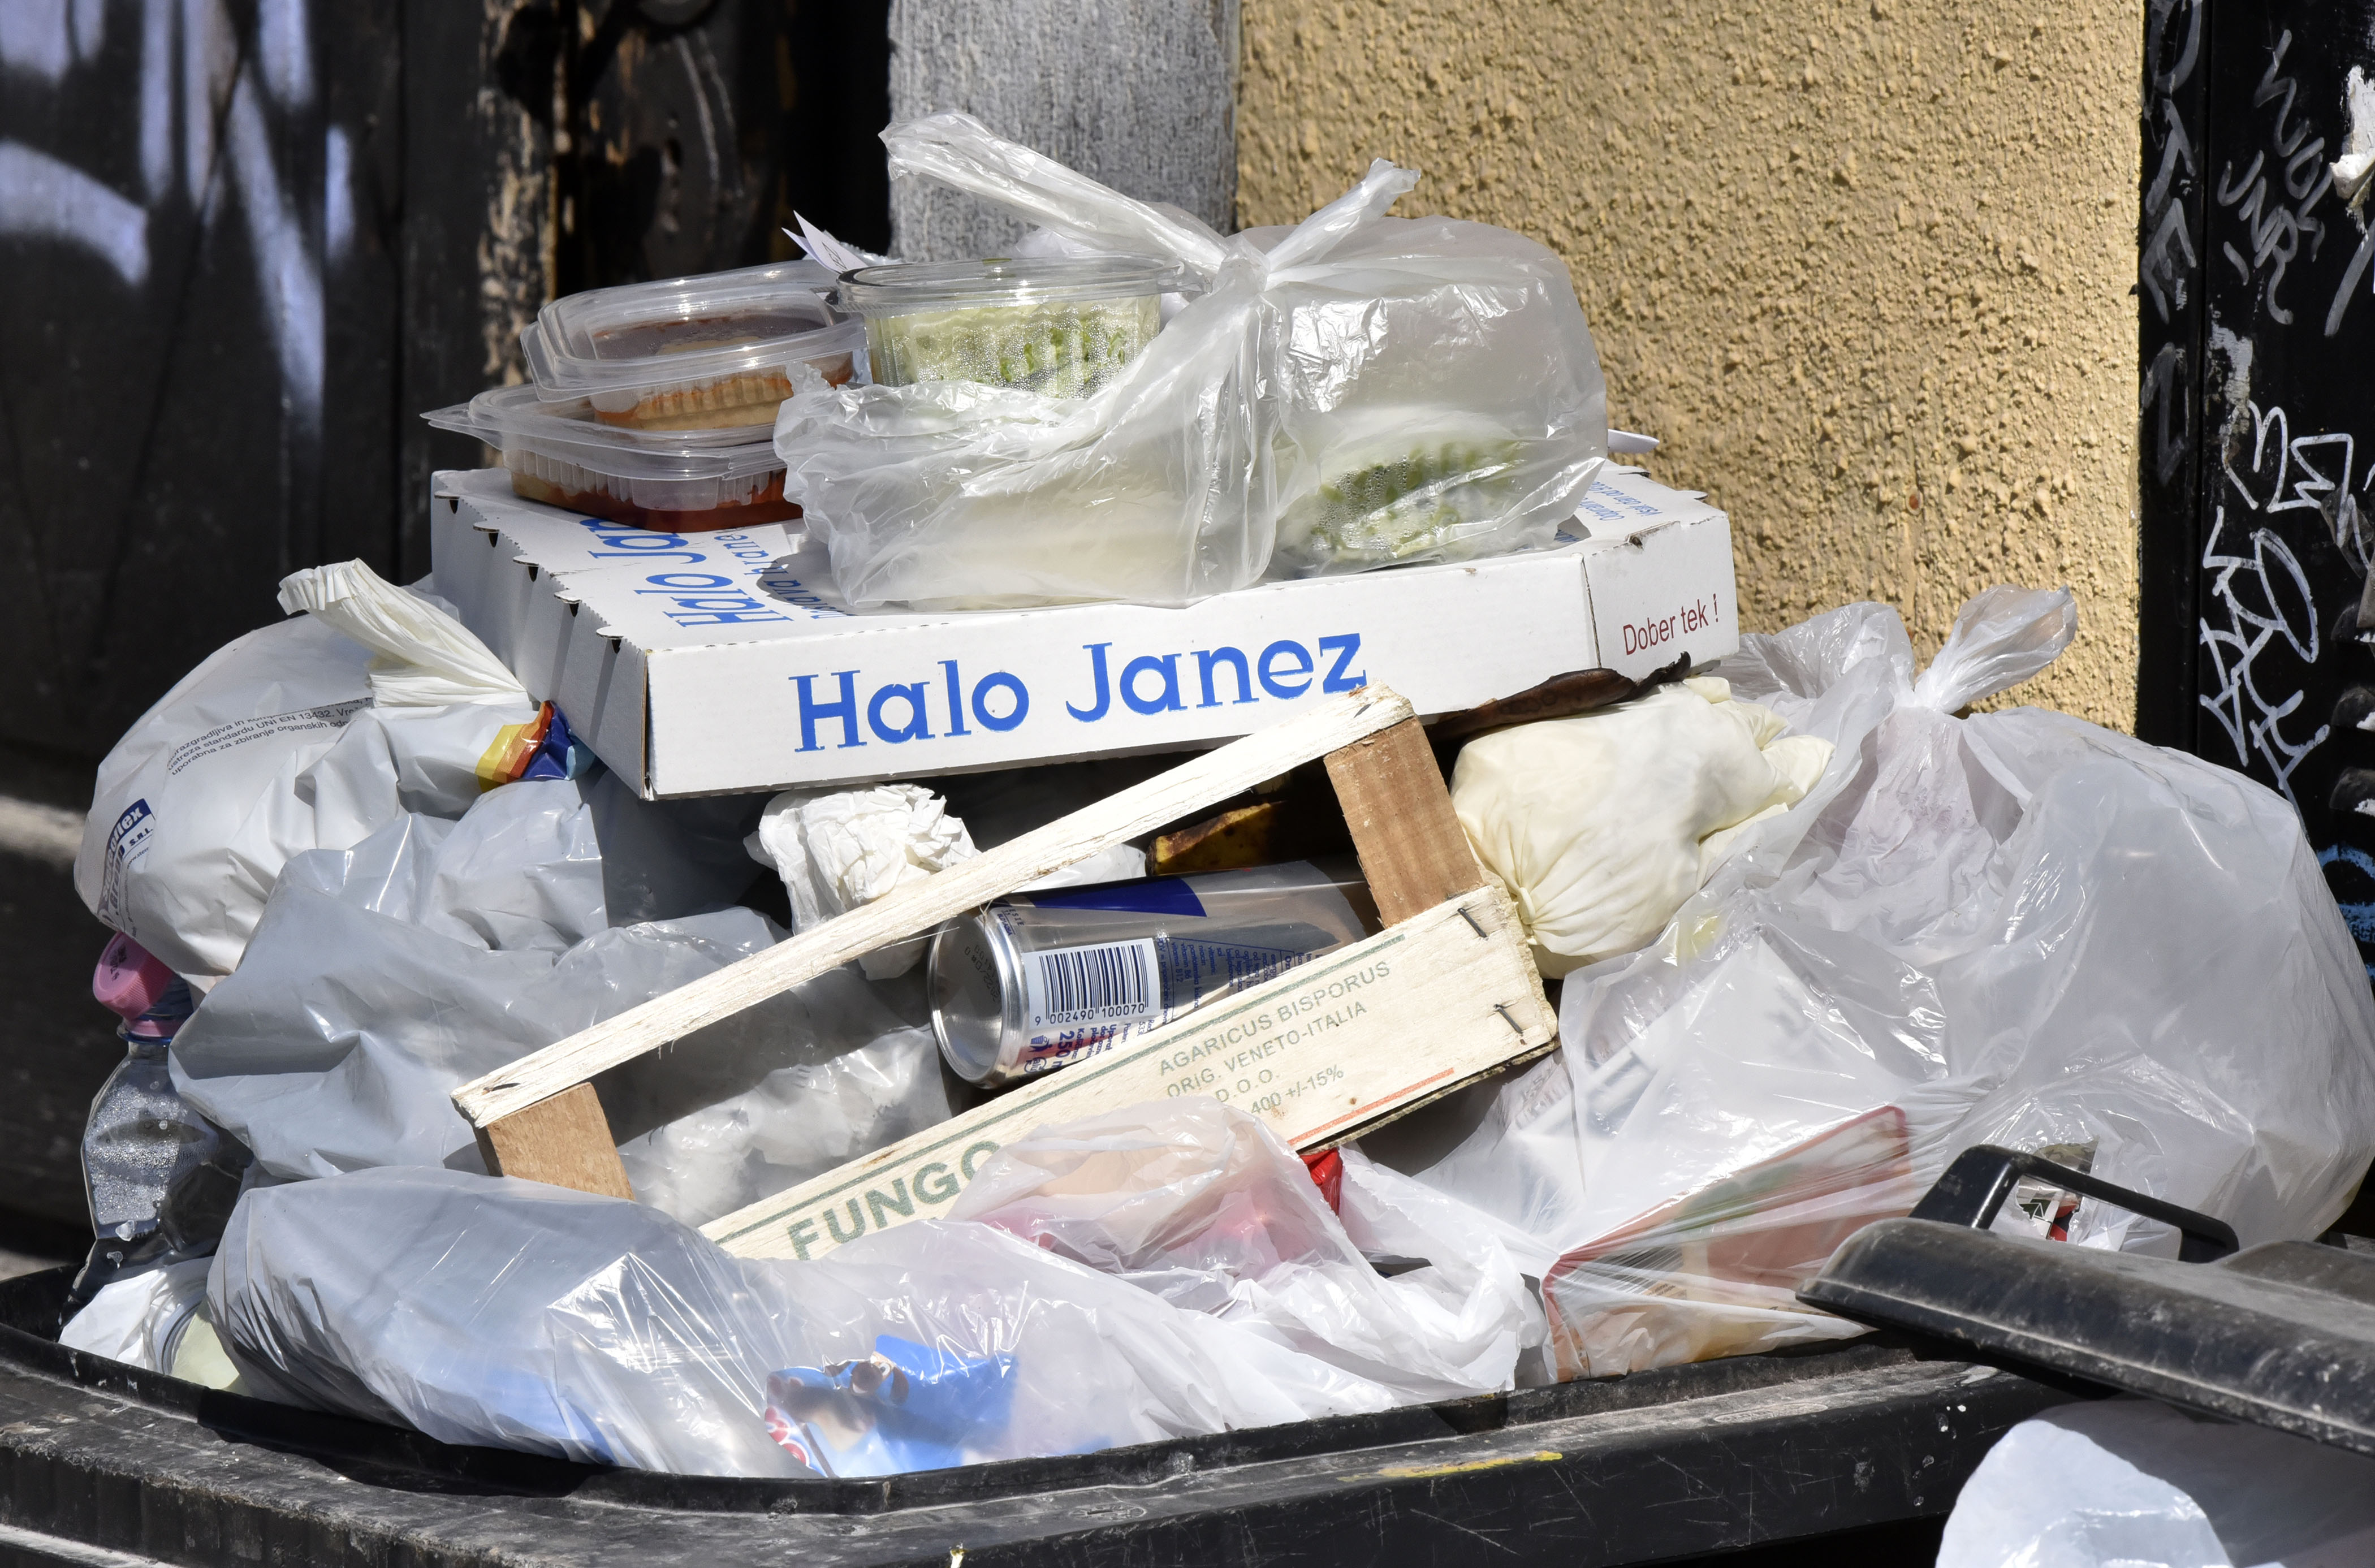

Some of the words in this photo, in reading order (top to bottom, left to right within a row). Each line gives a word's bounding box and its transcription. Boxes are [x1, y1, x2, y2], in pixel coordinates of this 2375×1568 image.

[714, 534, 789, 576] hrane
[634, 573, 794, 627] Halo
[1623, 616, 1676, 655] Dober
[1681, 599, 1709, 634] tek
[789, 659, 1029, 752] Halo
[1066, 633, 1366, 723] Janez
[169, 746, 201, 771] ustreza
[204, 726, 254, 747] standardu
[256, 718, 277, 729] UNI
[279, 715, 296, 723] EN
[299, 710, 335, 720] 13432.
[172, 748, 217, 775] uporabna
[234, 729, 275, 745] zbiranje
[277, 722, 327, 732] organskih
[1035, 1016, 1041, 1026] 9
[1050, 1009, 1094, 1024] 002490
[1102, 1003, 1145, 1018] 100070
[1160, 1014, 1272, 1076] AGARICUS
[1278, 961, 1390, 1023] BISPORUS
[1056, 1030, 1075, 1058] 250
[1167, 1068, 1221, 1099] ORIG.
[1224, 1001, 1367, 1073] VENETO-ITALIA
[1215, 1069, 1280, 1103] D.O.O.
[1251, 1092, 1282, 1115] 400
